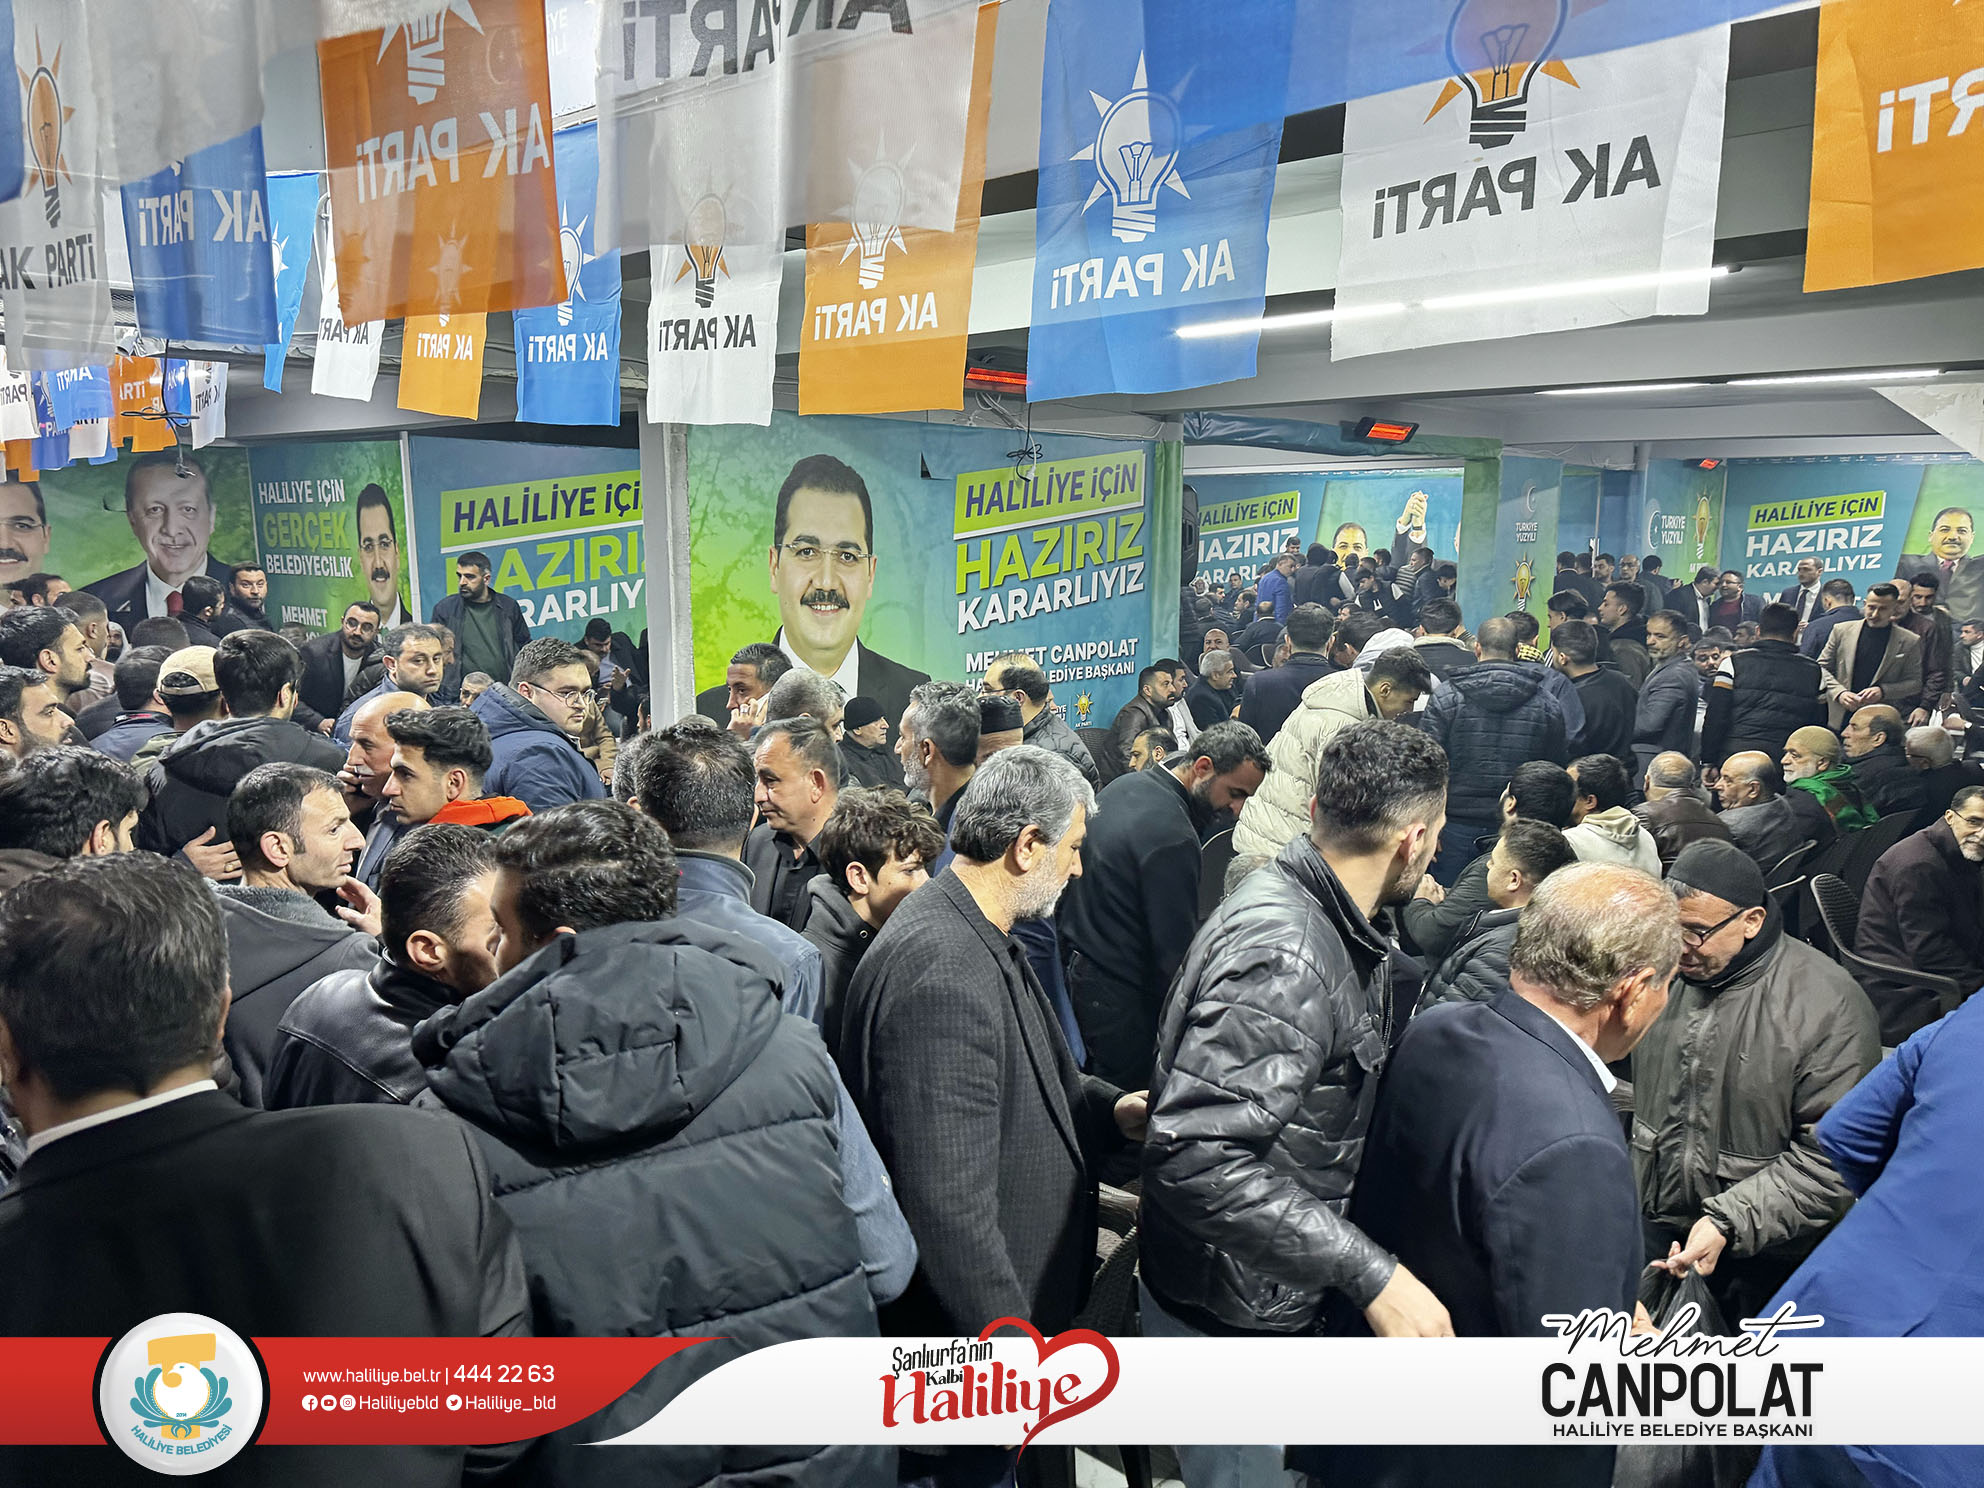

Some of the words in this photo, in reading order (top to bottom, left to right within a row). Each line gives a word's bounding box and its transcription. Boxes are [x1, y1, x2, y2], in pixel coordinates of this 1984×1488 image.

[453, 483, 597, 533] HALİLİYE
[604, 480, 642, 517] İÇİ
[1755, 501, 1837, 523] HALİLİYE
[263, 511, 350, 552] GERÇEK
[1746, 523, 1883, 558] HAZIRIZ
[445, 531, 645, 597] AZIRI
[955, 511, 1145, 595] HAZIRIZ
[282, 605, 328, 628] MEHMET
[516, 578, 645, 628] RARLIY
[957, 561, 1145, 634] KARARLIYIZ
[1051, 638, 1139, 664] CANPOLAT
[1086, 661, 1136, 681] BAŞKANI
